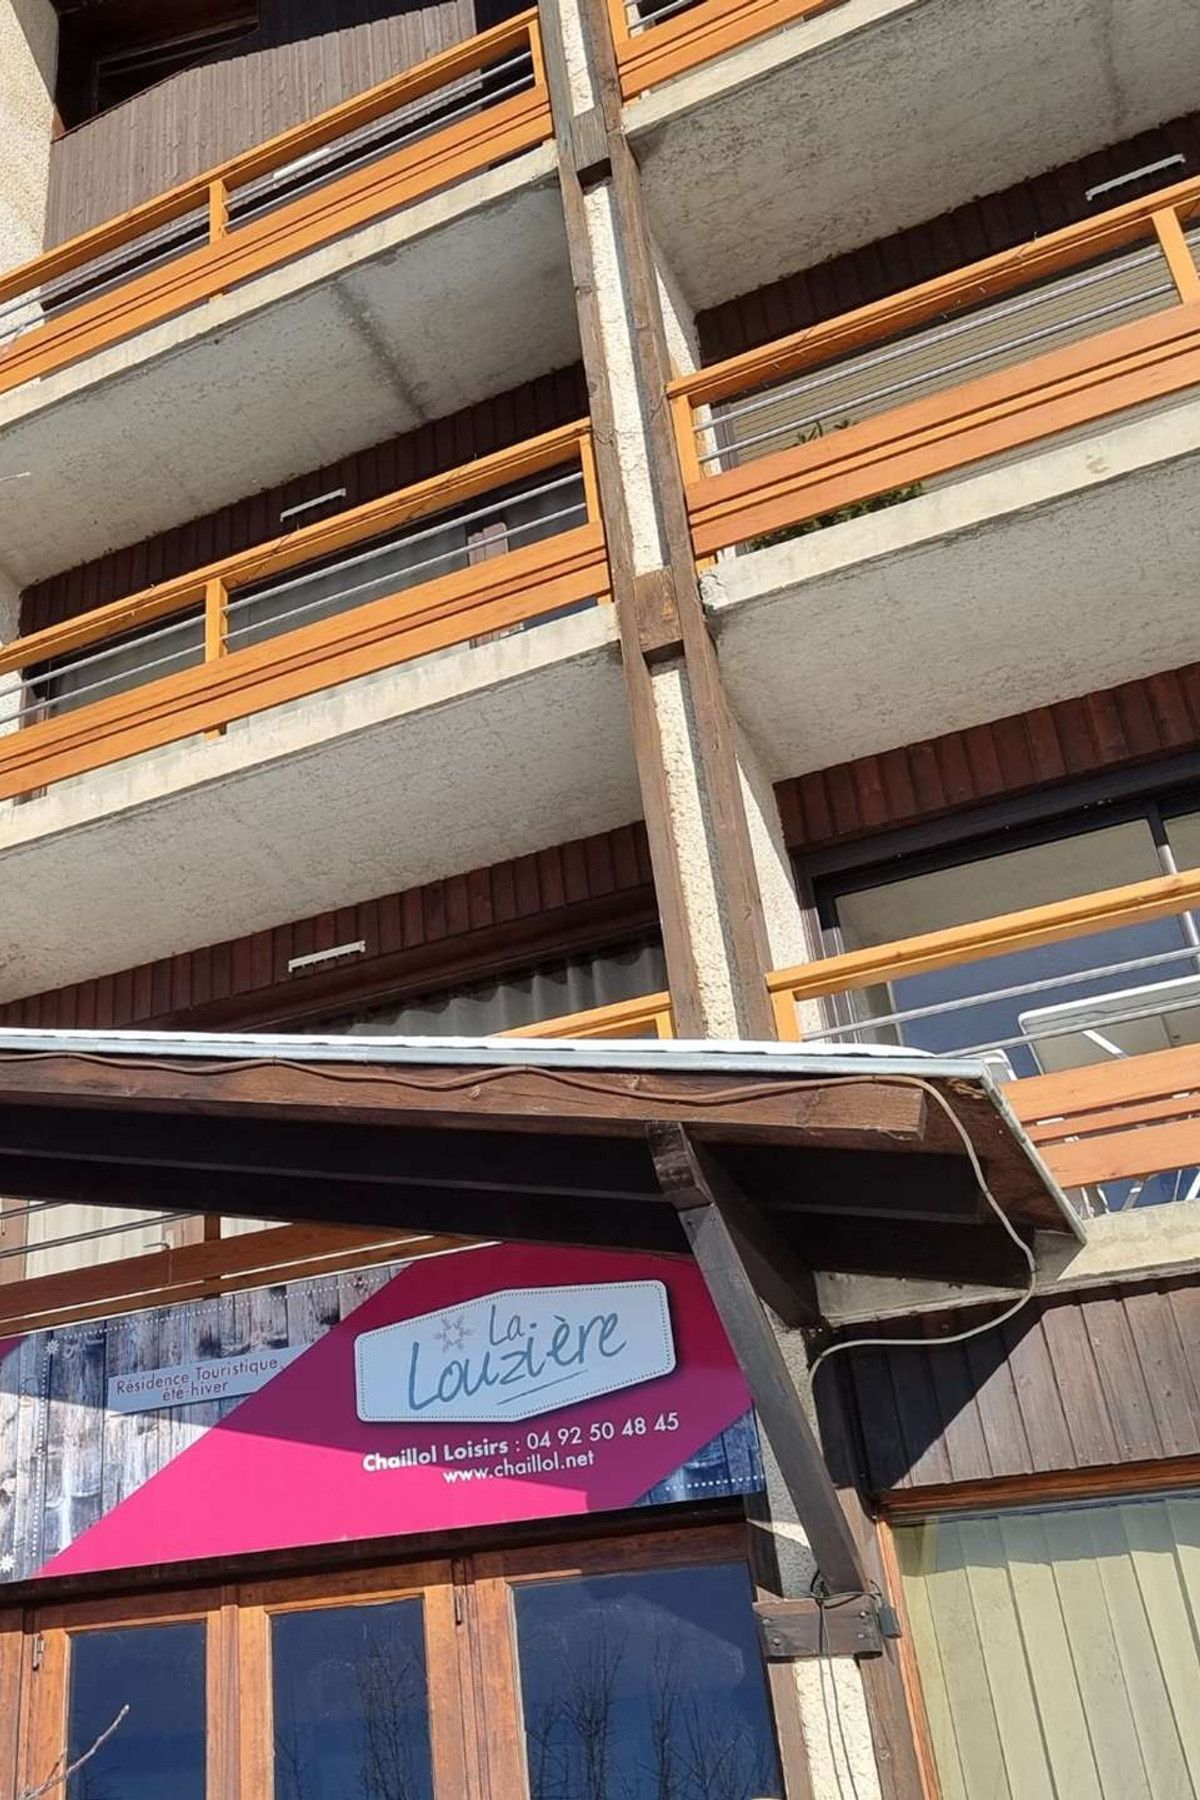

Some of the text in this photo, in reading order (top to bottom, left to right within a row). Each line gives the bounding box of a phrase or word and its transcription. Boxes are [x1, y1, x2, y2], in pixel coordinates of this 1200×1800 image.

[489, 1304, 525, 1346] La
[117, 1358, 278, 1395] Résidence Touristique
[162, 1381, 228, 1402] été-hiver
[362, 1444, 437, 1472] Chaillol
[443, 1438, 509, 1461] Loisirs
[527, 1431, 551, 1450] 04
[557, 1426, 583, 1446] 92
[589, 1421, 615, 1442] 50
[621, 1416, 647, 1437] 48
[653, 1411, 680, 1432] 45
[443, 1449, 595, 1485] www.chaillol.net
